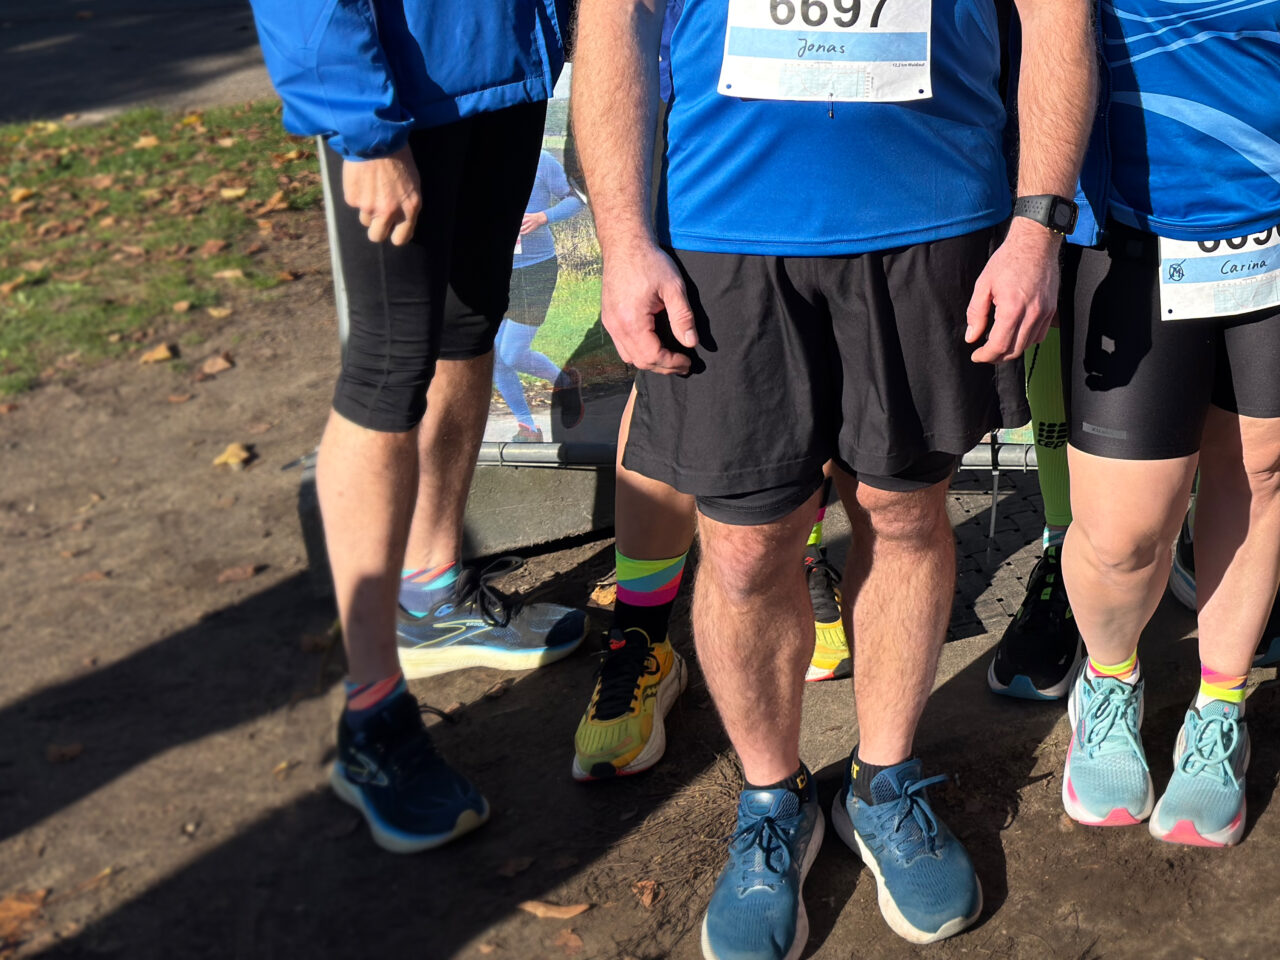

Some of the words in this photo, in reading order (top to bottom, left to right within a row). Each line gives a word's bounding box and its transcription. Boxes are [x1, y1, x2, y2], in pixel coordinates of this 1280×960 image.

[798, 38, 846, 58] Jonas
[1220, 259, 1268, 275] Carina
[1037, 438, 1067, 449] cep
